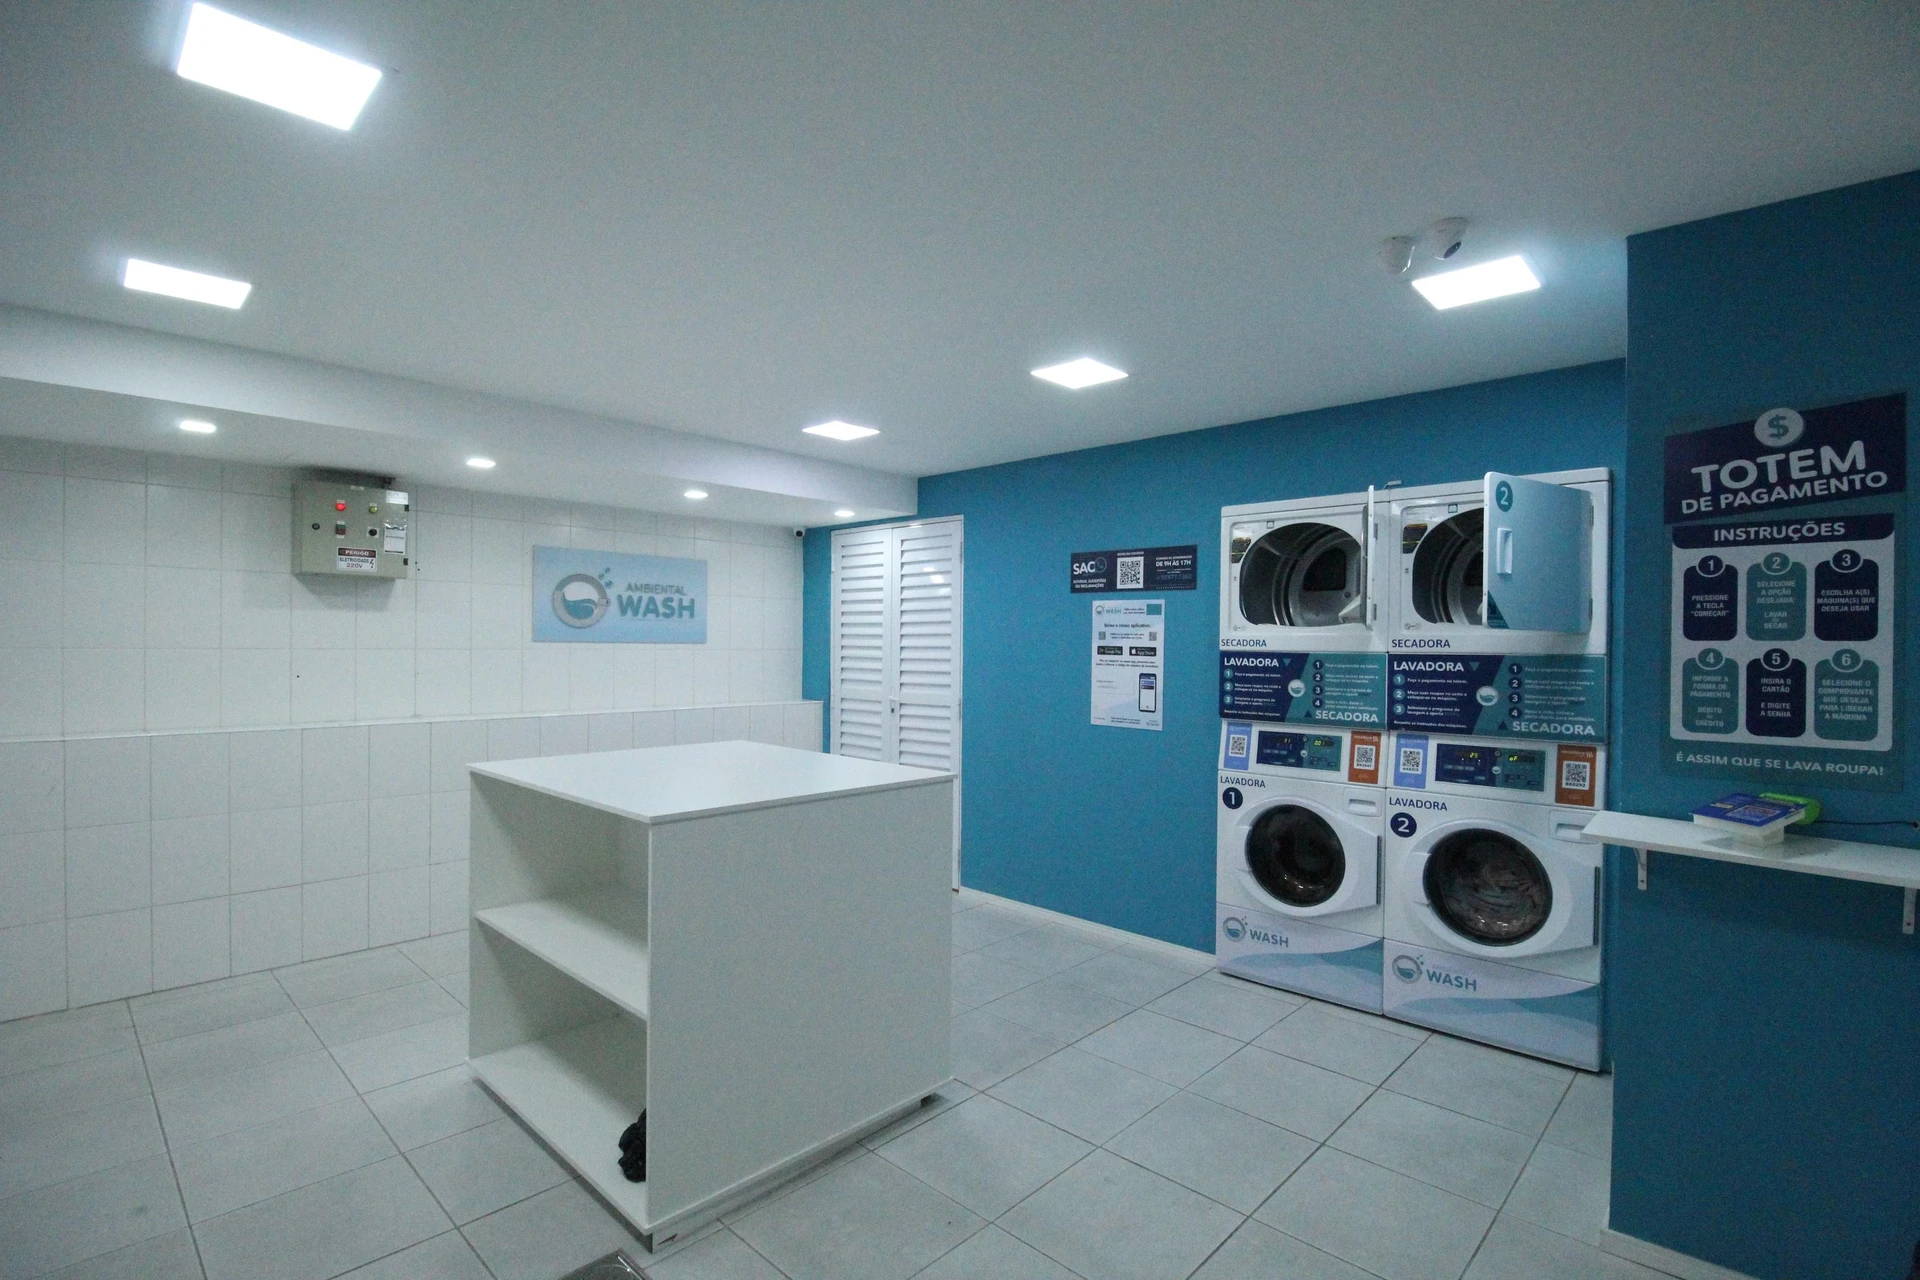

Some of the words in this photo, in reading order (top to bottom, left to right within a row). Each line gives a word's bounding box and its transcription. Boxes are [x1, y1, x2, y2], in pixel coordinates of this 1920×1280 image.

[1691, 440, 1866, 493] TOTEM
[1500, 487, 1508, 505] 2
[1681, 497, 1712, 515] DE
[1720, 470, 1888, 509] PAGAMENTO
[1713, 521, 1846, 541] INSTRUÇÕES
[1707, 560, 1715, 571] 1
[1771, 557, 1781, 569] 2
[1842, 554, 1851, 567] 3
[1073, 561, 1095, 575] SAC
[624, 583, 687, 595] AMBIENTAL
[617, 594, 695, 619] WASH
[1221, 639, 1267, 647] SECADORA
[1392, 639, 1450, 648] SECADORA
[1224, 658, 1279, 667] LAVADORA
[1706, 652, 1715, 664] 4
[1771, 653, 1781, 665] 5
[1841, 654, 1851, 666] 6
[1394, 661, 1464, 671] LAVADORA
[1762, 685, 1790, 693] CARTÃO
[1821, 679, 1863, 687] SELECIONE
[1512, 694, 1518, 702] 3
[1818, 688, 1874, 696] COMPROVANTE
[1315, 699, 1320, 707] 4
[1396, 705, 1402, 713] 3
[1315, 711, 1379, 722] SECADORA
[1512, 709, 1518, 717] 4
[1512, 721, 1595, 736] SECADORA
[1676, 752, 1684, 762] É
[1686, 755, 1728, 765] ASSIM
[1731, 757, 1761, 767] QUE
[1764, 759, 1781, 769] SE
[1785, 761, 1822, 771] LAVA
[1825, 763, 1884, 776] ROUPA!
[1220, 776, 1266, 788] LAVADORA
[1229, 791, 1235, 805] 1
[1389, 797, 1448, 811] LAVADORA
[1397, 817, 1410, 833] 2
[1249, 929, 1289, 948] WASH
[1426, 969, 1477, 991] WASH
